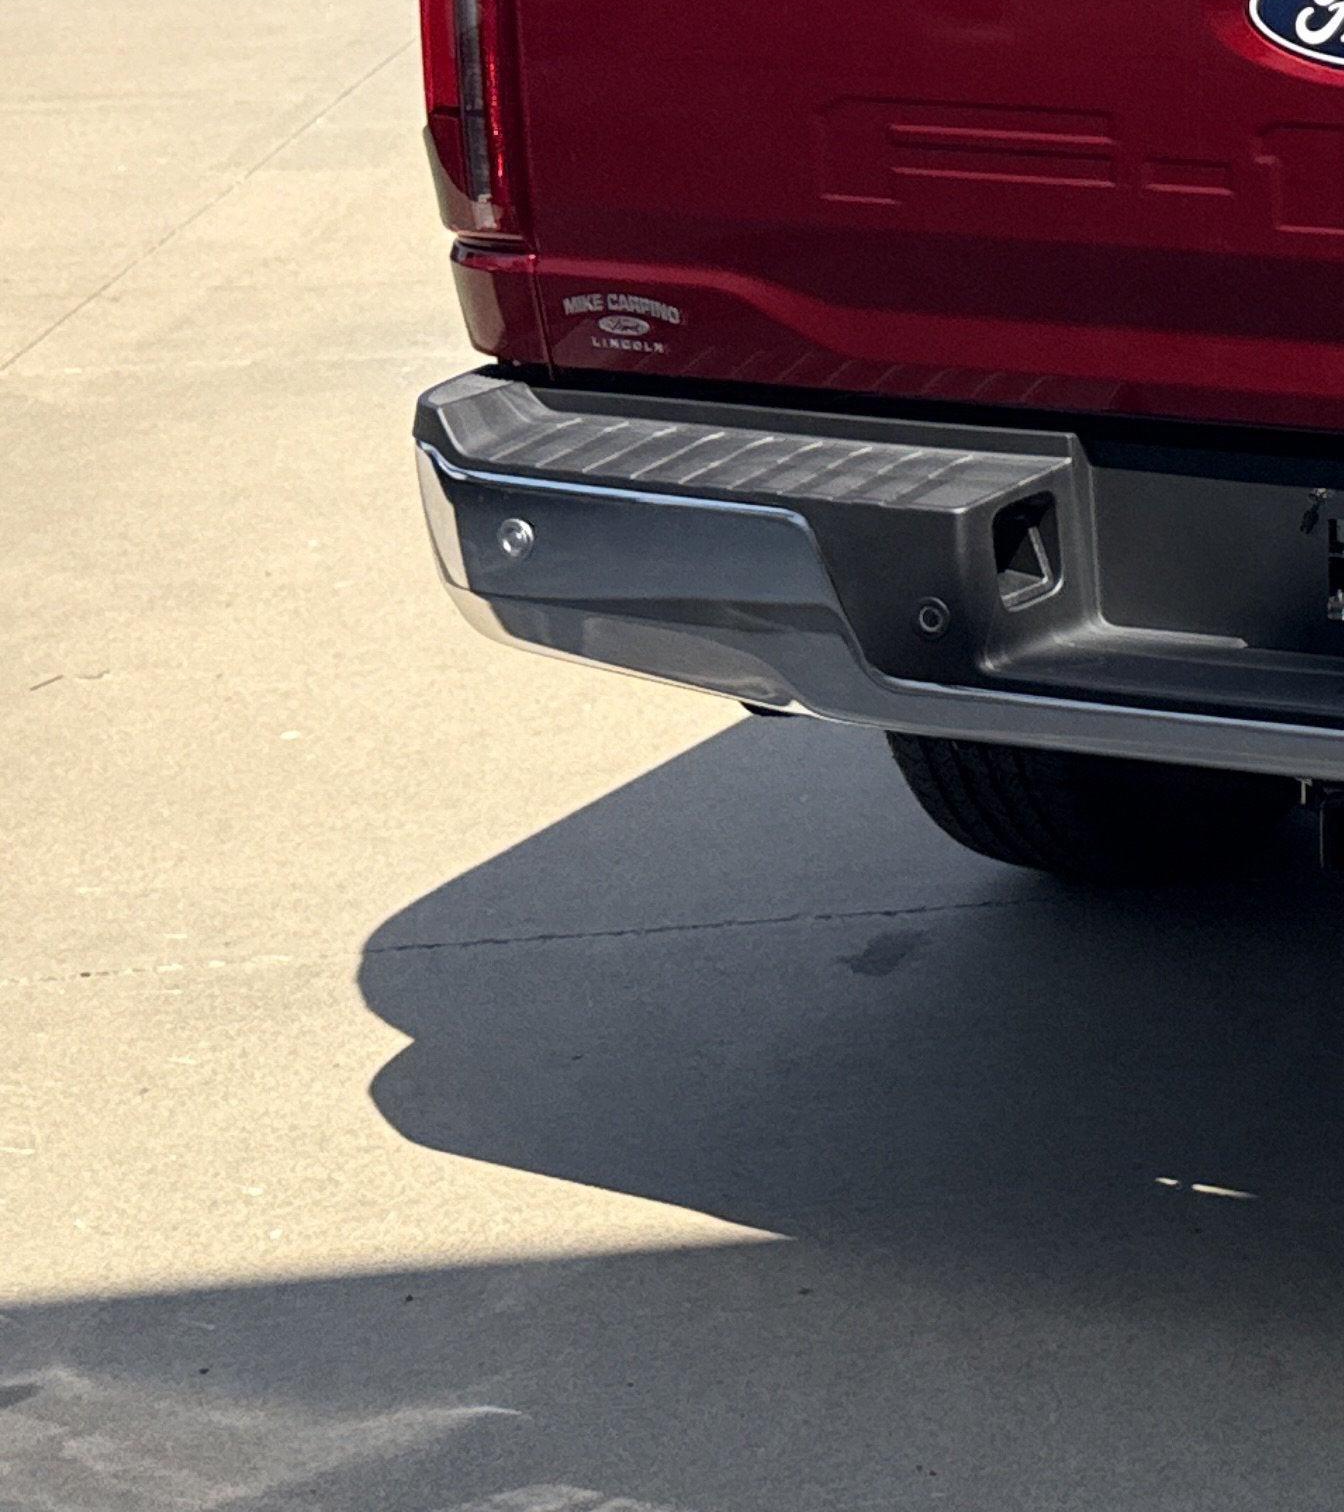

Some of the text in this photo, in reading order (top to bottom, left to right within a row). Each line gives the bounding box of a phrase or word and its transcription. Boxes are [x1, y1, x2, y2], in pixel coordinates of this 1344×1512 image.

[562, 293, 681, 324] MIKE CARPINO
[591, 336, 665, 354] LINCOLN
